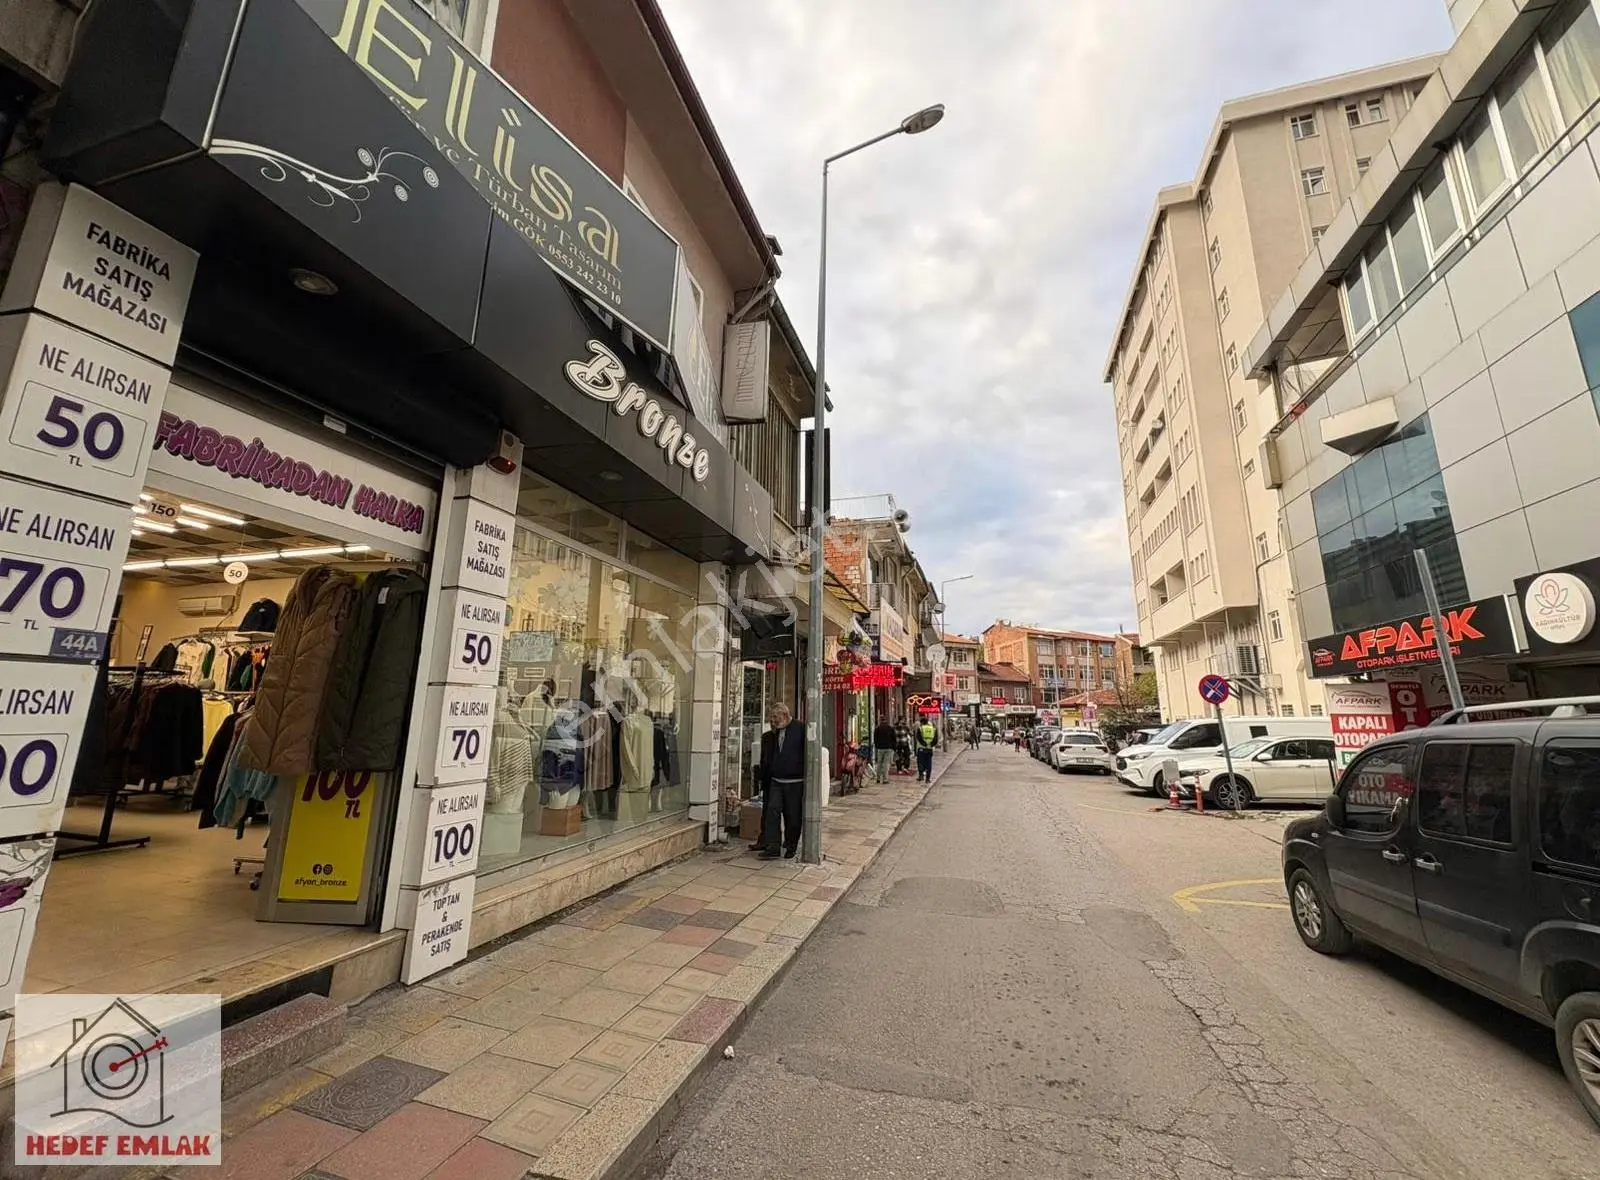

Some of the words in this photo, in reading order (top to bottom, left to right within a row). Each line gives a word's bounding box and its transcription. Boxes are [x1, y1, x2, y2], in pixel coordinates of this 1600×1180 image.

[468, 157, 528, 233] Türban
[553, 223, 622, 291] Tasarım
[87, 222, 171, 281] FABRİKA
[513, 218, 546, 249] GÖK
[576, 265, 595, 285] 242
[597, 281, 609, 295] 23
[611, 291, 622, 305] 10
[94, 257, 153, 302] SATIŞ
[62, 272, 168, 334] MAĞAZASI
[39, 343, 70, 374] NE
[71, 358, 152, 404] ALIRSAN
[36, 395, 124, 460] 50
[68, 454, 84, 467] TL
[153, 411, 353, 510] FABRİKADAN
[351, 484, 425, 535] HALKA
[151, 503, 175, 517] 150
[26, 513, 116, 551] ALIRSAN
[474, 520, 506, 542] FABRİKA
[477, 541, 500, 561] SATIŞ
[229, 569, 243, 579] 50
[466, 557, 506, 579] MAĞAZASI
[0, 558, 85, 618] 70
[23, 619, 39, 630] TL
[461, 604, 472, 620] NE
[472, 606, 501, 625] ALIRSAN
[61, 634, 98, 652] 44A
[1340, 605, 1486, 661] AFPARK
[461, 633, 492, 666] 50
[1356, 655, 1396, 669] OTOPARK
[1438, 683, 1506, 695] APARK
[449, 701, 460, 716] NE
[461, 700, 489, 716] ALIRSAN
[1336, 696, 1382, 705] AFPARK
[1338, 716, 1388, 730] KAPALI
[452, 729, 480, 761] 70
[345, 799, 361, 818] TL
[437, 799, 447, 814] NE
[448, 794, 479, 813] ALIRSAN
[434, 823, 475, 863] 100
[294, 876, 347, 887] afyon_bronze
[433, 892, 461, 912] TOPTAN
[441, 911, 448, 922] &
[421, 918, 464, 945] PERAKENDE
[430, 938, 452, 957] SATIŞ
